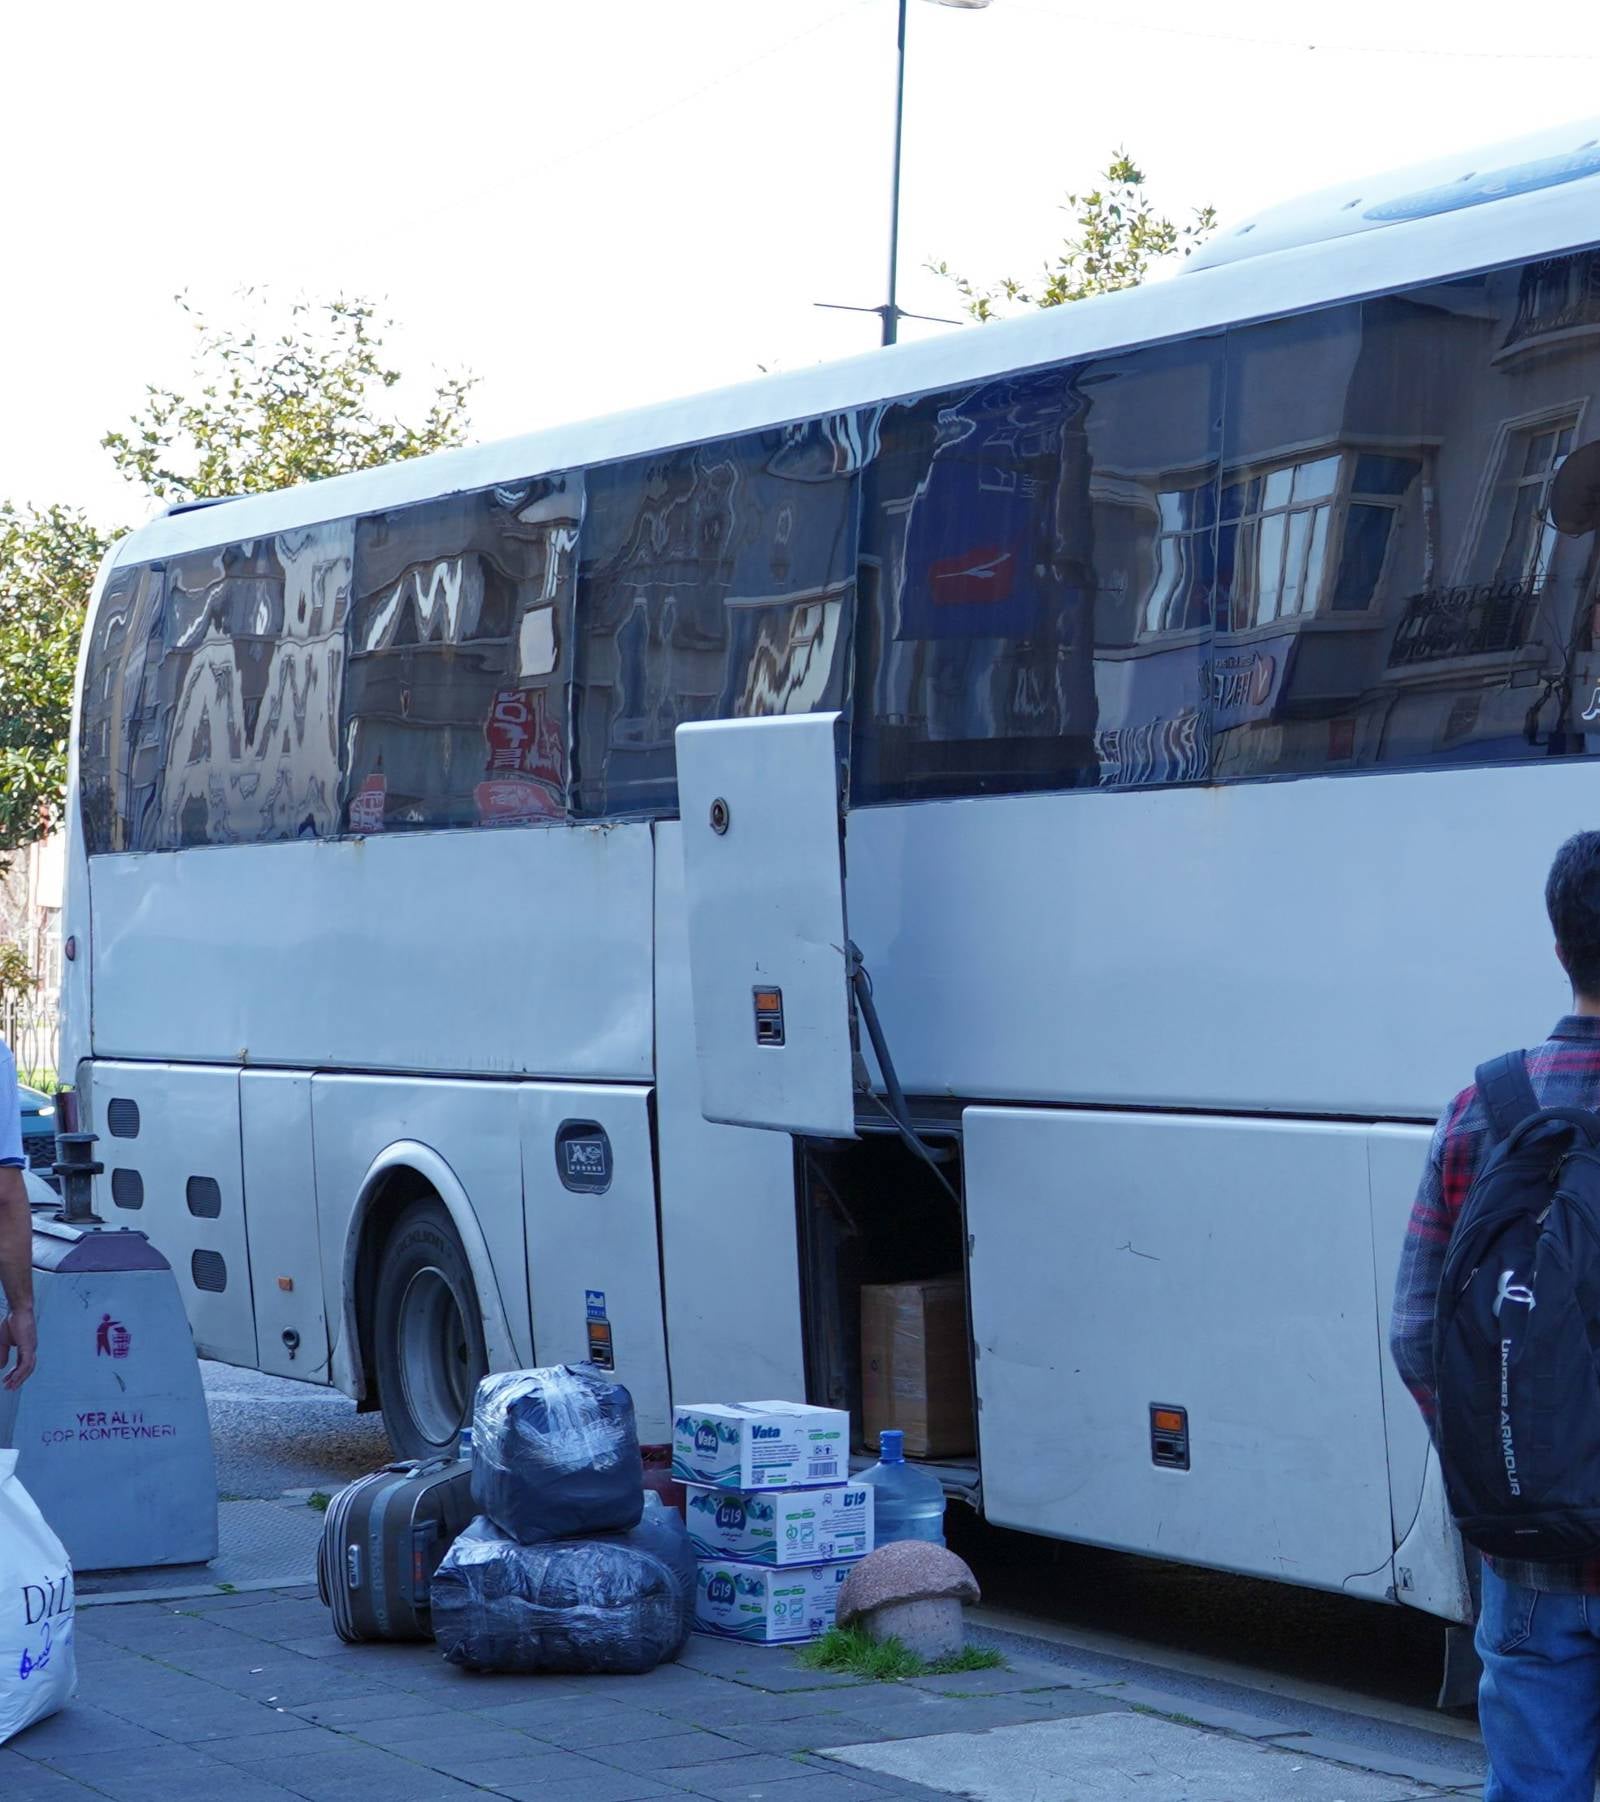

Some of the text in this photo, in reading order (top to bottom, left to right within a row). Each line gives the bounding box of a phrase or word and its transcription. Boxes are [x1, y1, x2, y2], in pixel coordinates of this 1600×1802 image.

[76, 1411, 107, 1427] YER
[1500, 1338, 1521, 1496] UNDER ARMOUR
[697, 1431, 717, 1448] Vata
[752, 1425, 780, 1439] Vata
